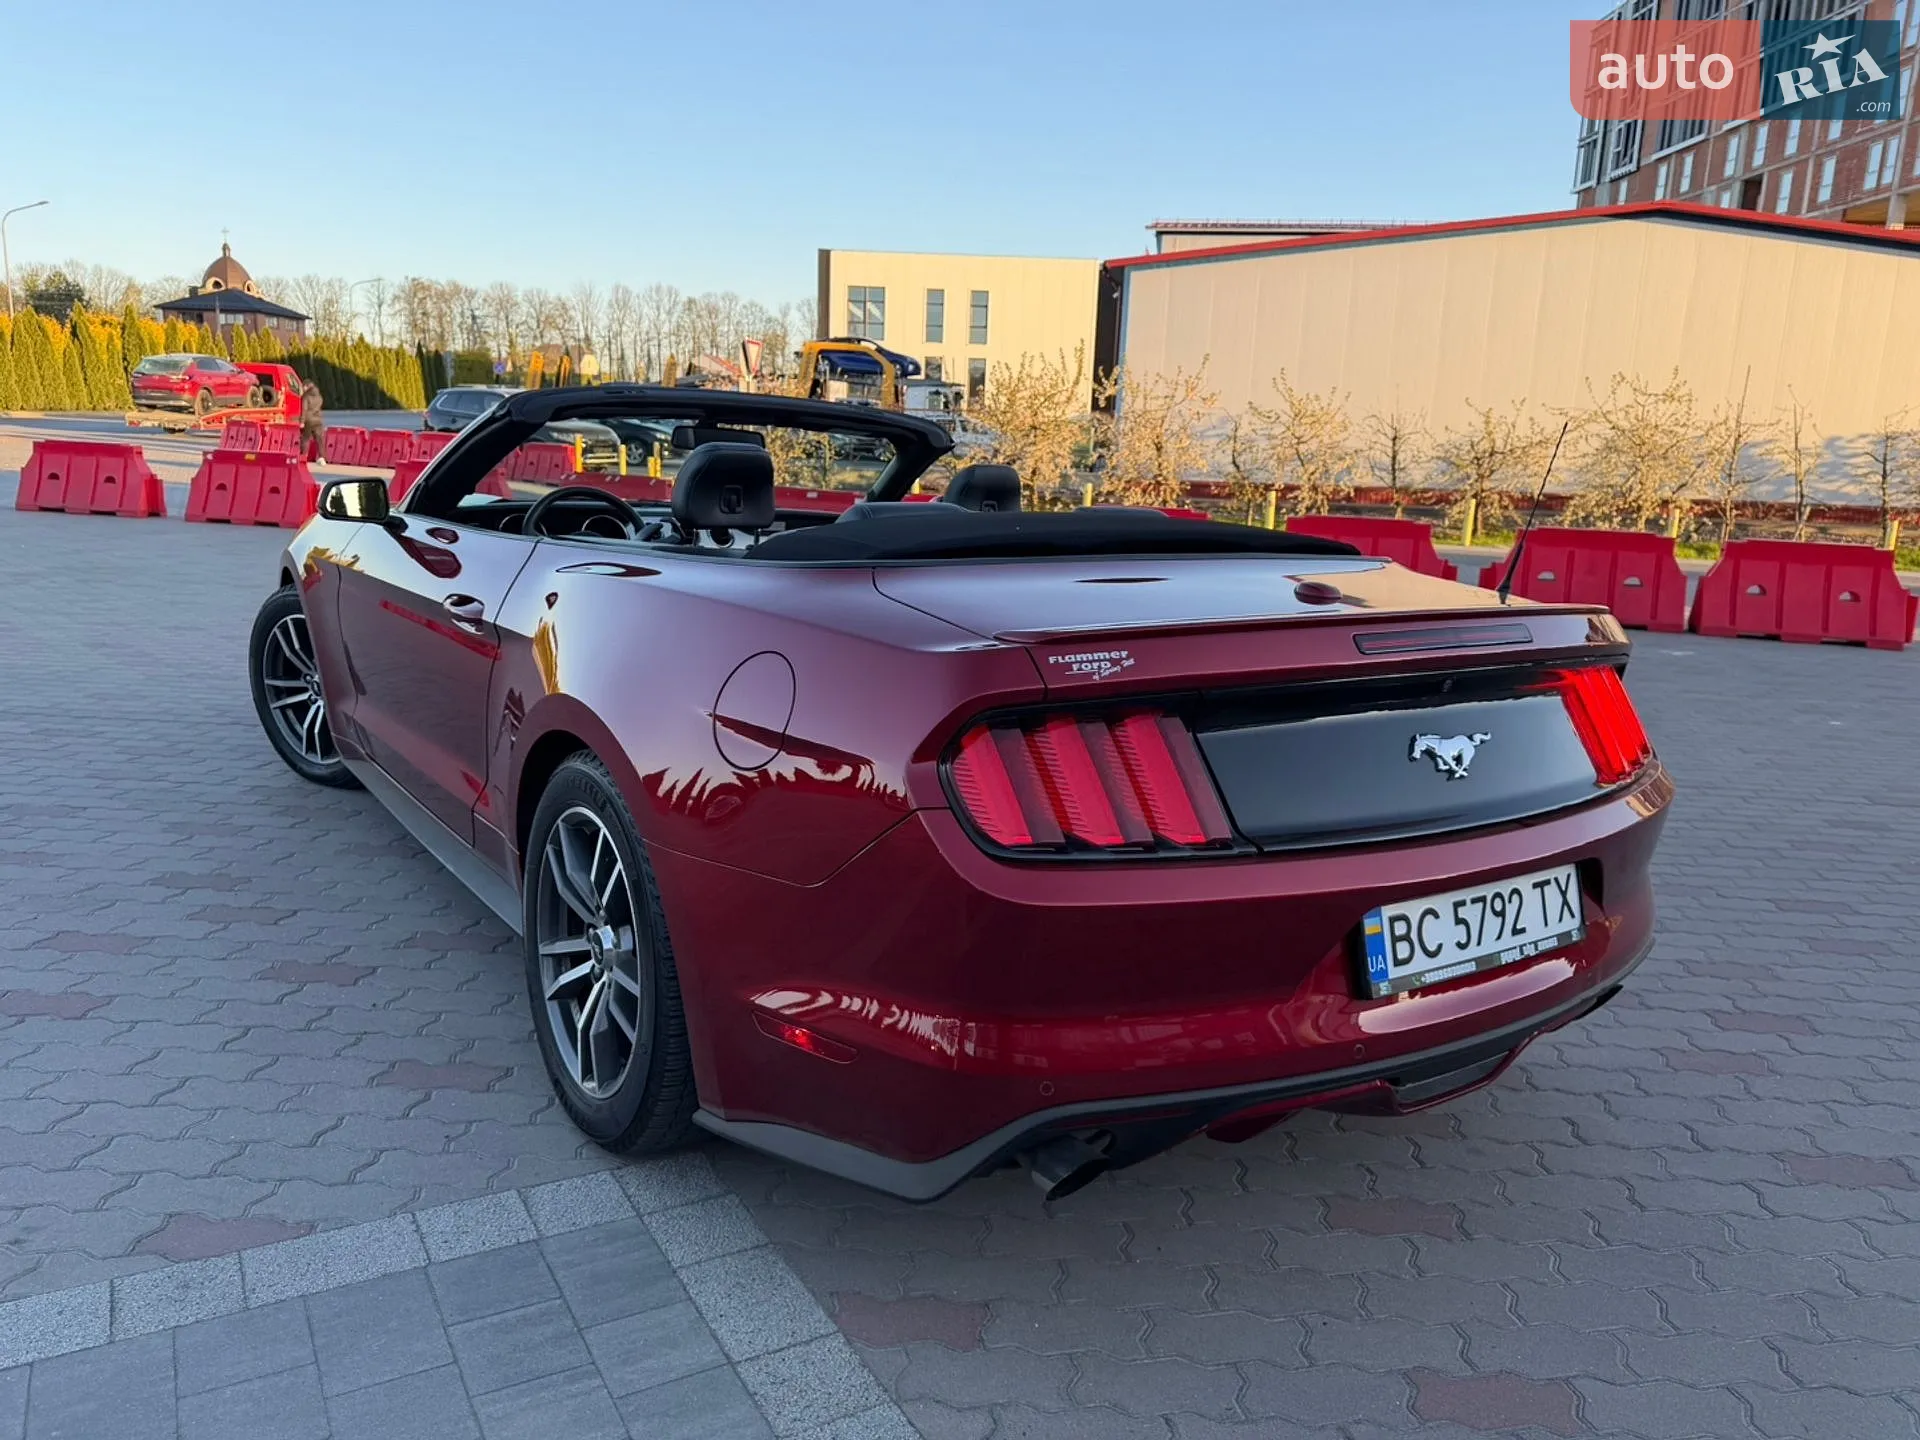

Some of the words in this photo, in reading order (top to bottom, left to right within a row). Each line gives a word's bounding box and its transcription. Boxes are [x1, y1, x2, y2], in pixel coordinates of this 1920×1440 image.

[1388, 906, 1443, 967] BC
[1452, 887, 1526, 951] 5792
[1532, 873, 1576, 928] TX
[1368, 955, 1386, 973] UA
